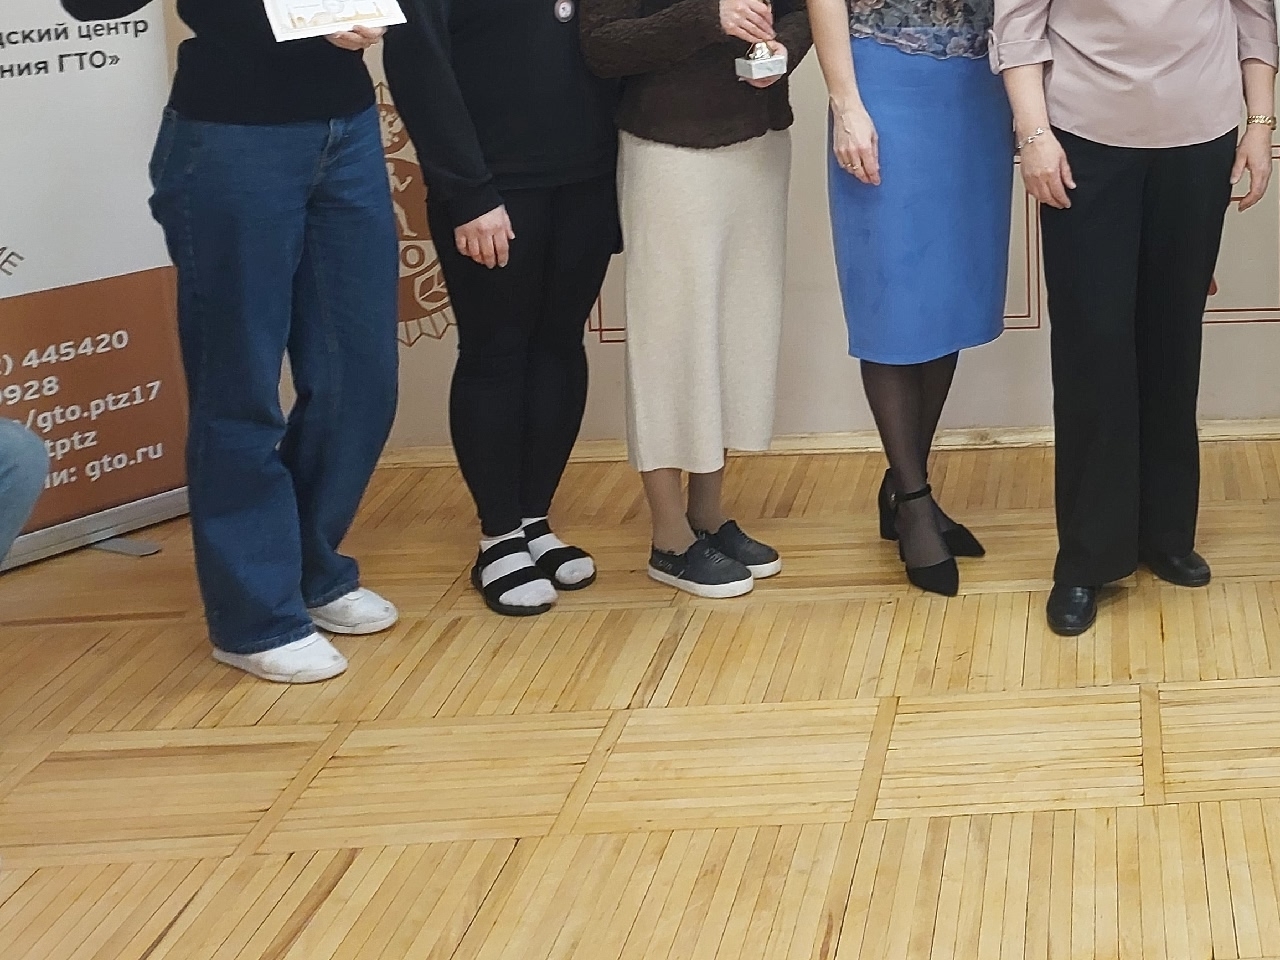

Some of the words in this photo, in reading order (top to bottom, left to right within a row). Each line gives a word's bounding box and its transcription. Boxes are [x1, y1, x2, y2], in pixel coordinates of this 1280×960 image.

[78, 19, 148, 40] центр
[0, 60, 49, 78] ния
[58, 50, 120, 73] ГТО»
[22, 330, 129, 368] 445420
[0, 375, 60, 406] 928
[12, 380, 162, 433] /gto.ptz17
[85, 442, 164, 482] gto.ru
